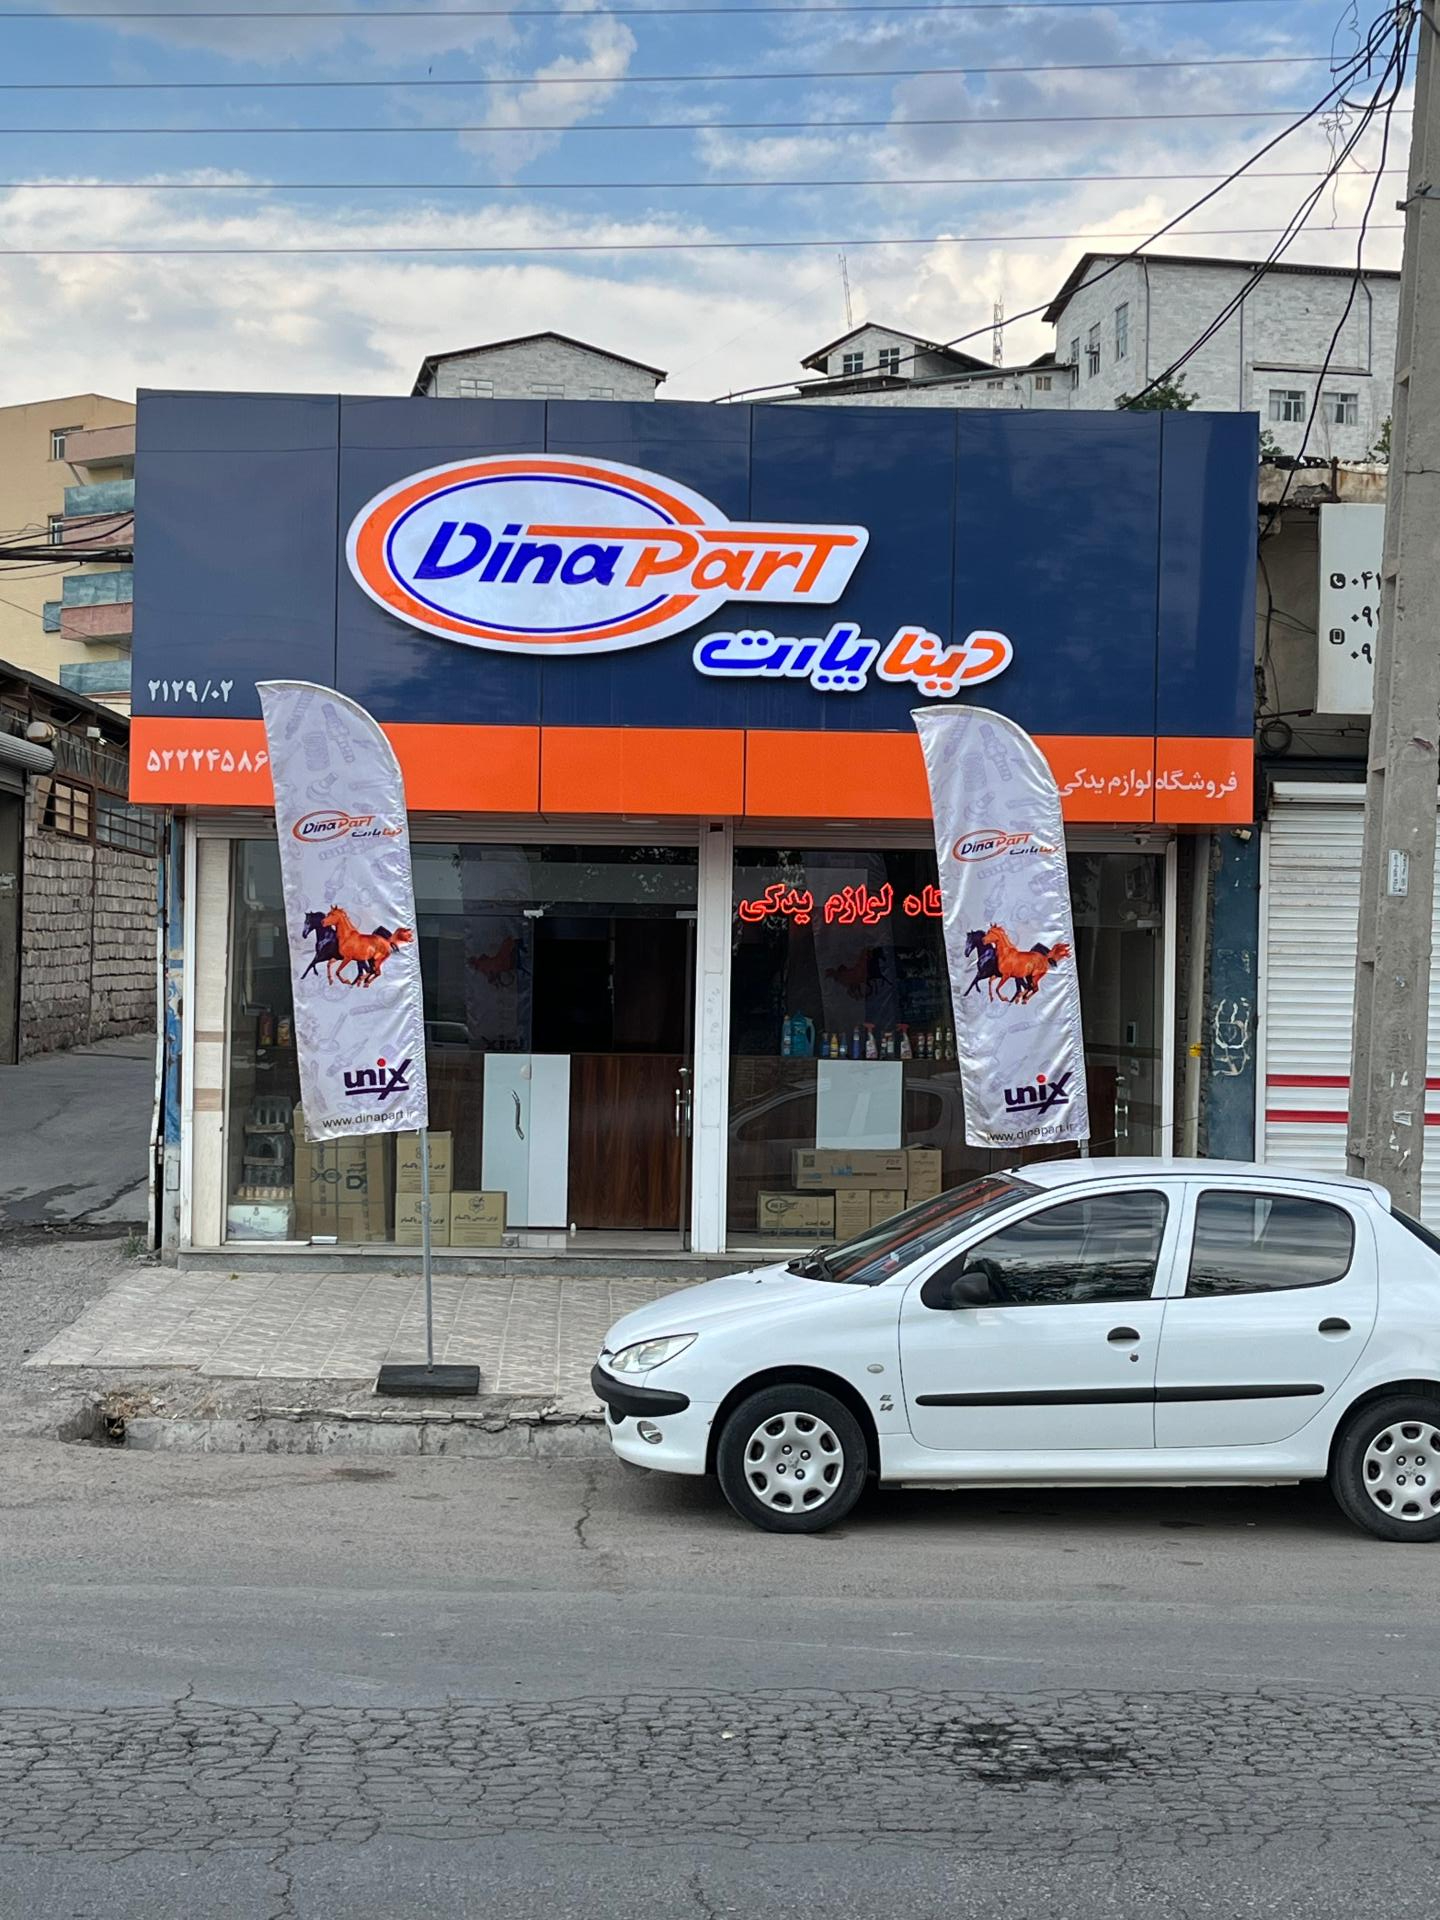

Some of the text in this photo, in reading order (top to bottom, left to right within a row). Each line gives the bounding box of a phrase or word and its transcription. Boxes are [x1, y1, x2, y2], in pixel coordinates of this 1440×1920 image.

[700, 629, 1006, 691] دینا پارت
[1058, 767, 1238, 799] فروشگاه لوازم یدکی
[739, 883, 814, 924] یدکی
[824, 881, 894, 924] لوازم
[343, 1057, 413, 1101] unix
[1004, 1071, 1073, 1116] unix
